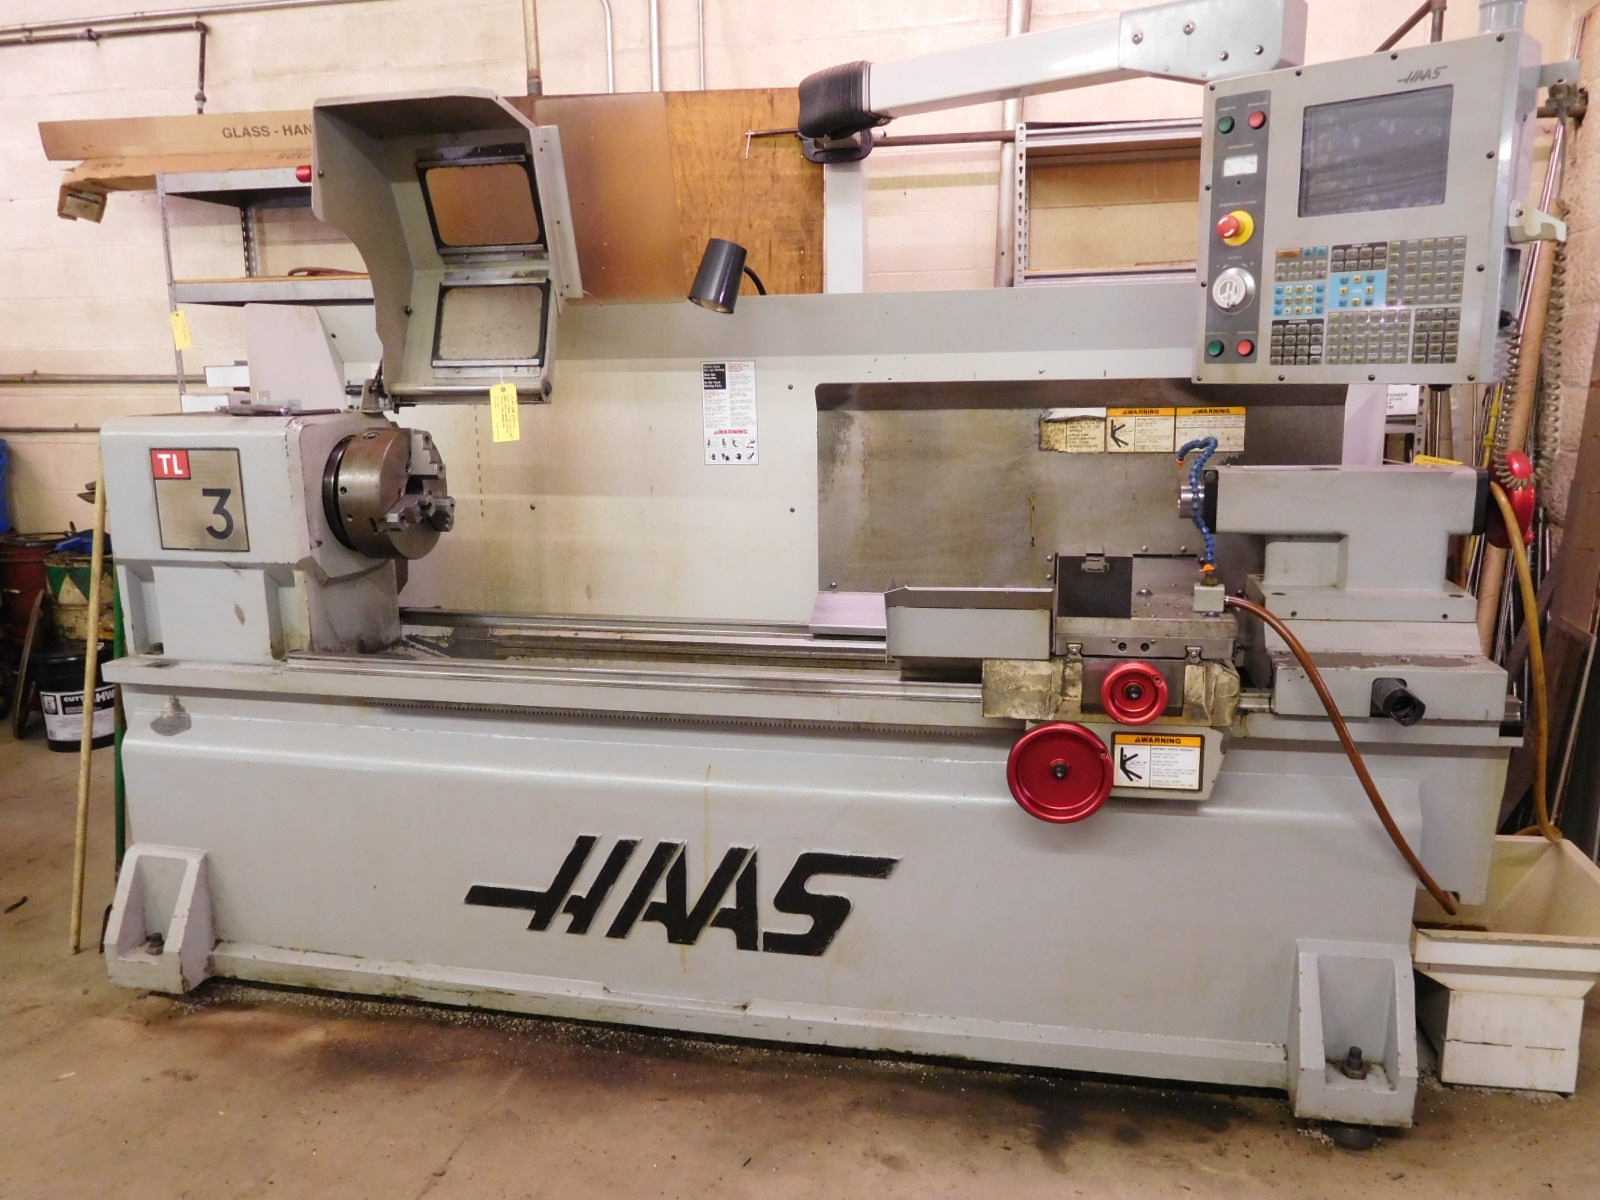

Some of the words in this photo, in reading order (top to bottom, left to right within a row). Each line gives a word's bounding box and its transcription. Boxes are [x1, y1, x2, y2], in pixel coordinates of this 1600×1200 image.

[1397, 65, 1448, 84] HAAS
[221, 125, 271, 139] GLASS
[157, 453, 183, 475] TL
[202, 488, 234, 540] 3
[463, 834, 903, 957] HAAS
